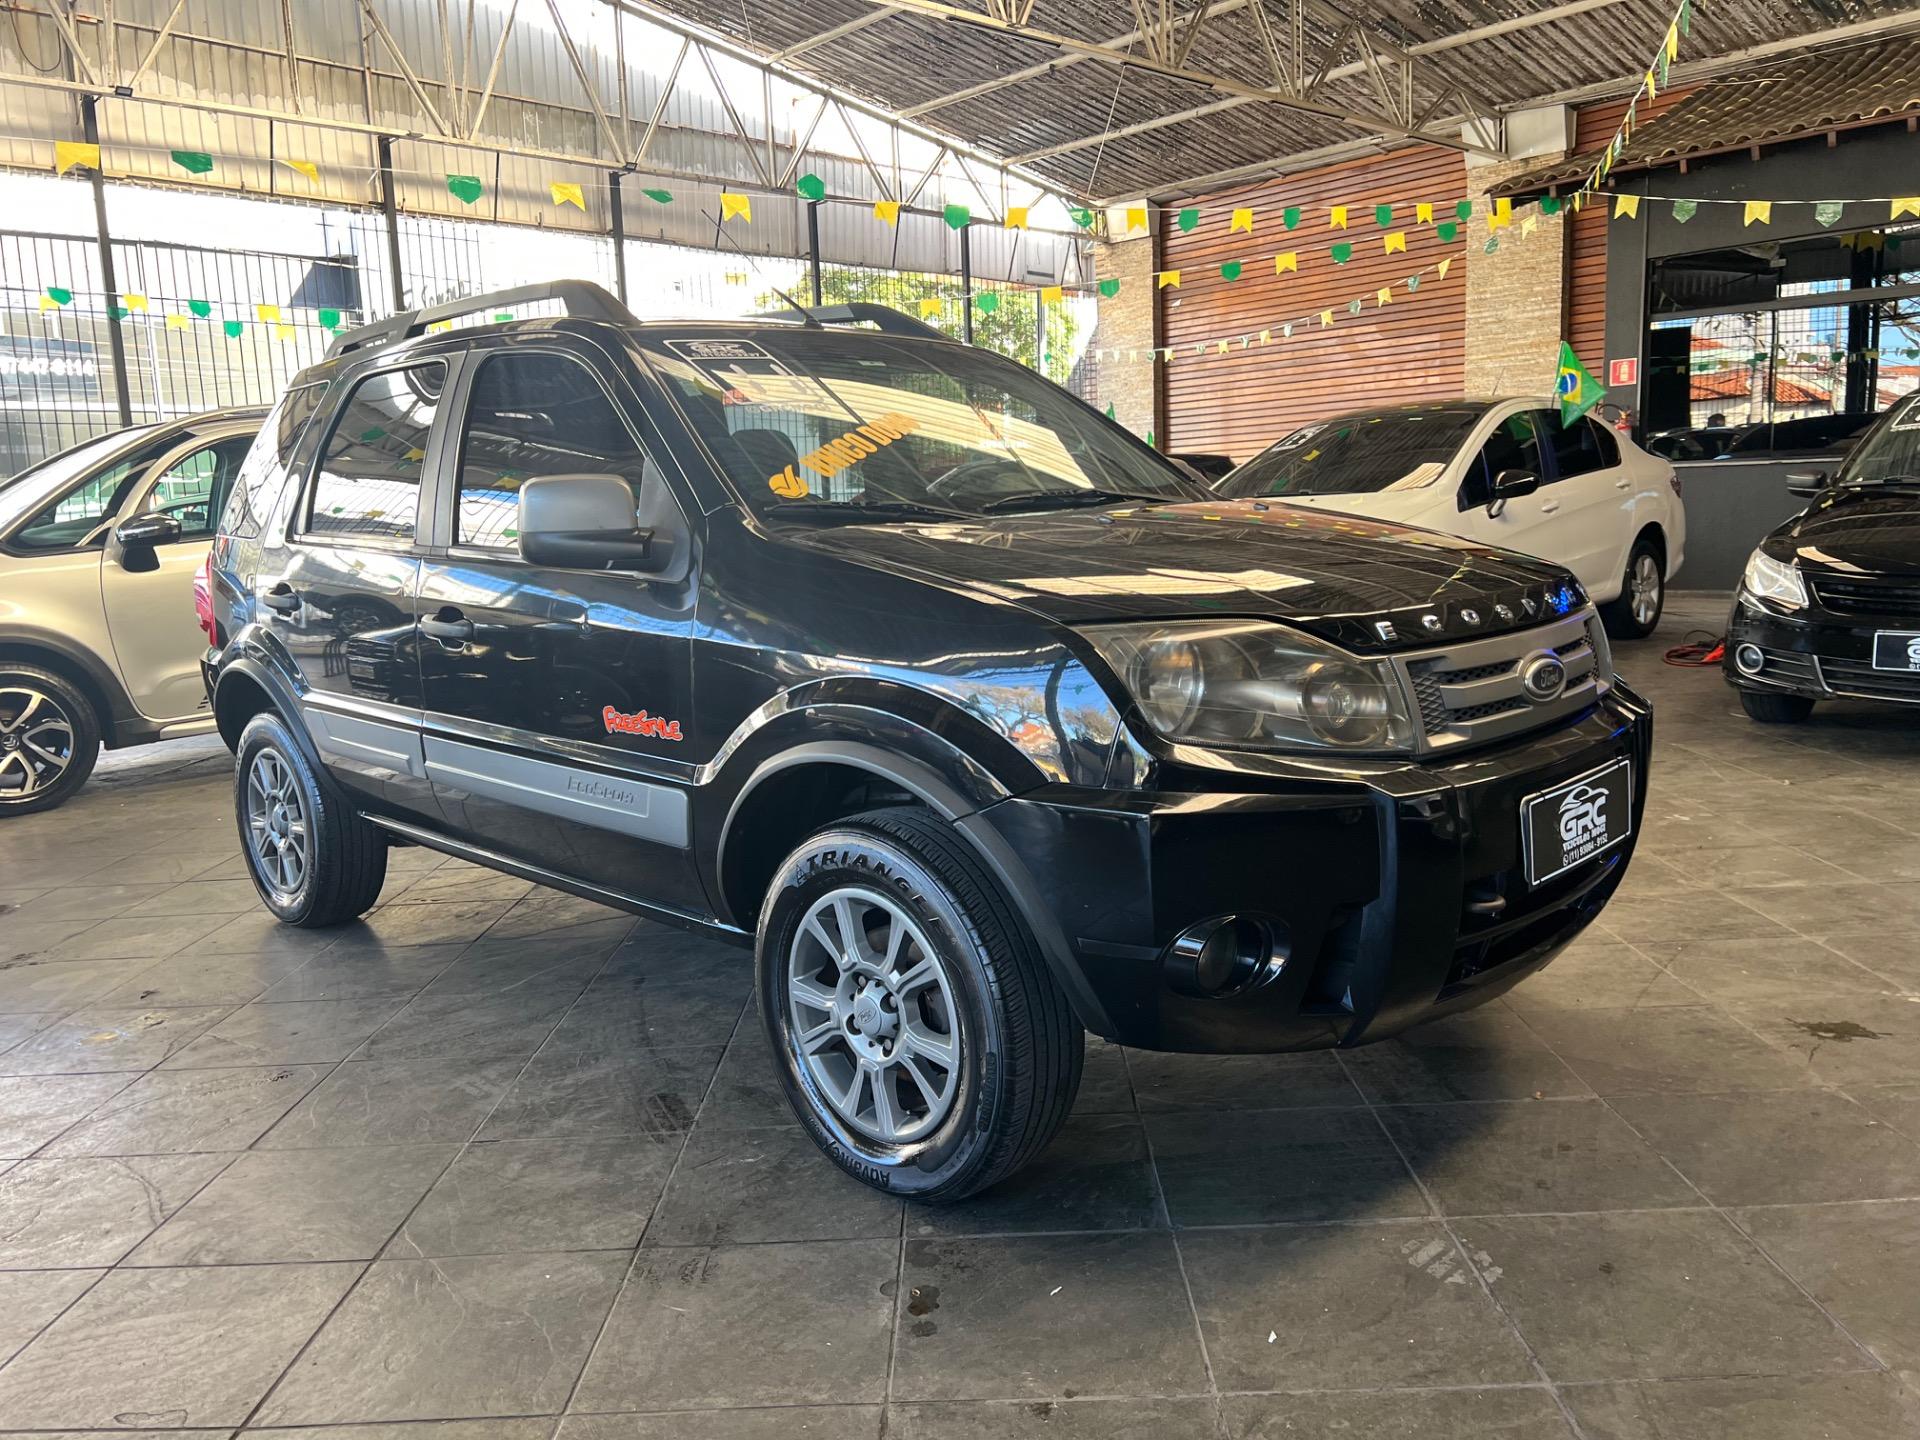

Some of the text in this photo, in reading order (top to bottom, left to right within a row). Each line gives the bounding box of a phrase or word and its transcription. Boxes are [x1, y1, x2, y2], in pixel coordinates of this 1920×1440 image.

[1374, 584, 1585, 641] ECOSPO
[1540, 666, 1561, 688] Ford
[1560, 795, 1607, 841] GRC
[806, 850, 946, 936] TRIANGLE
